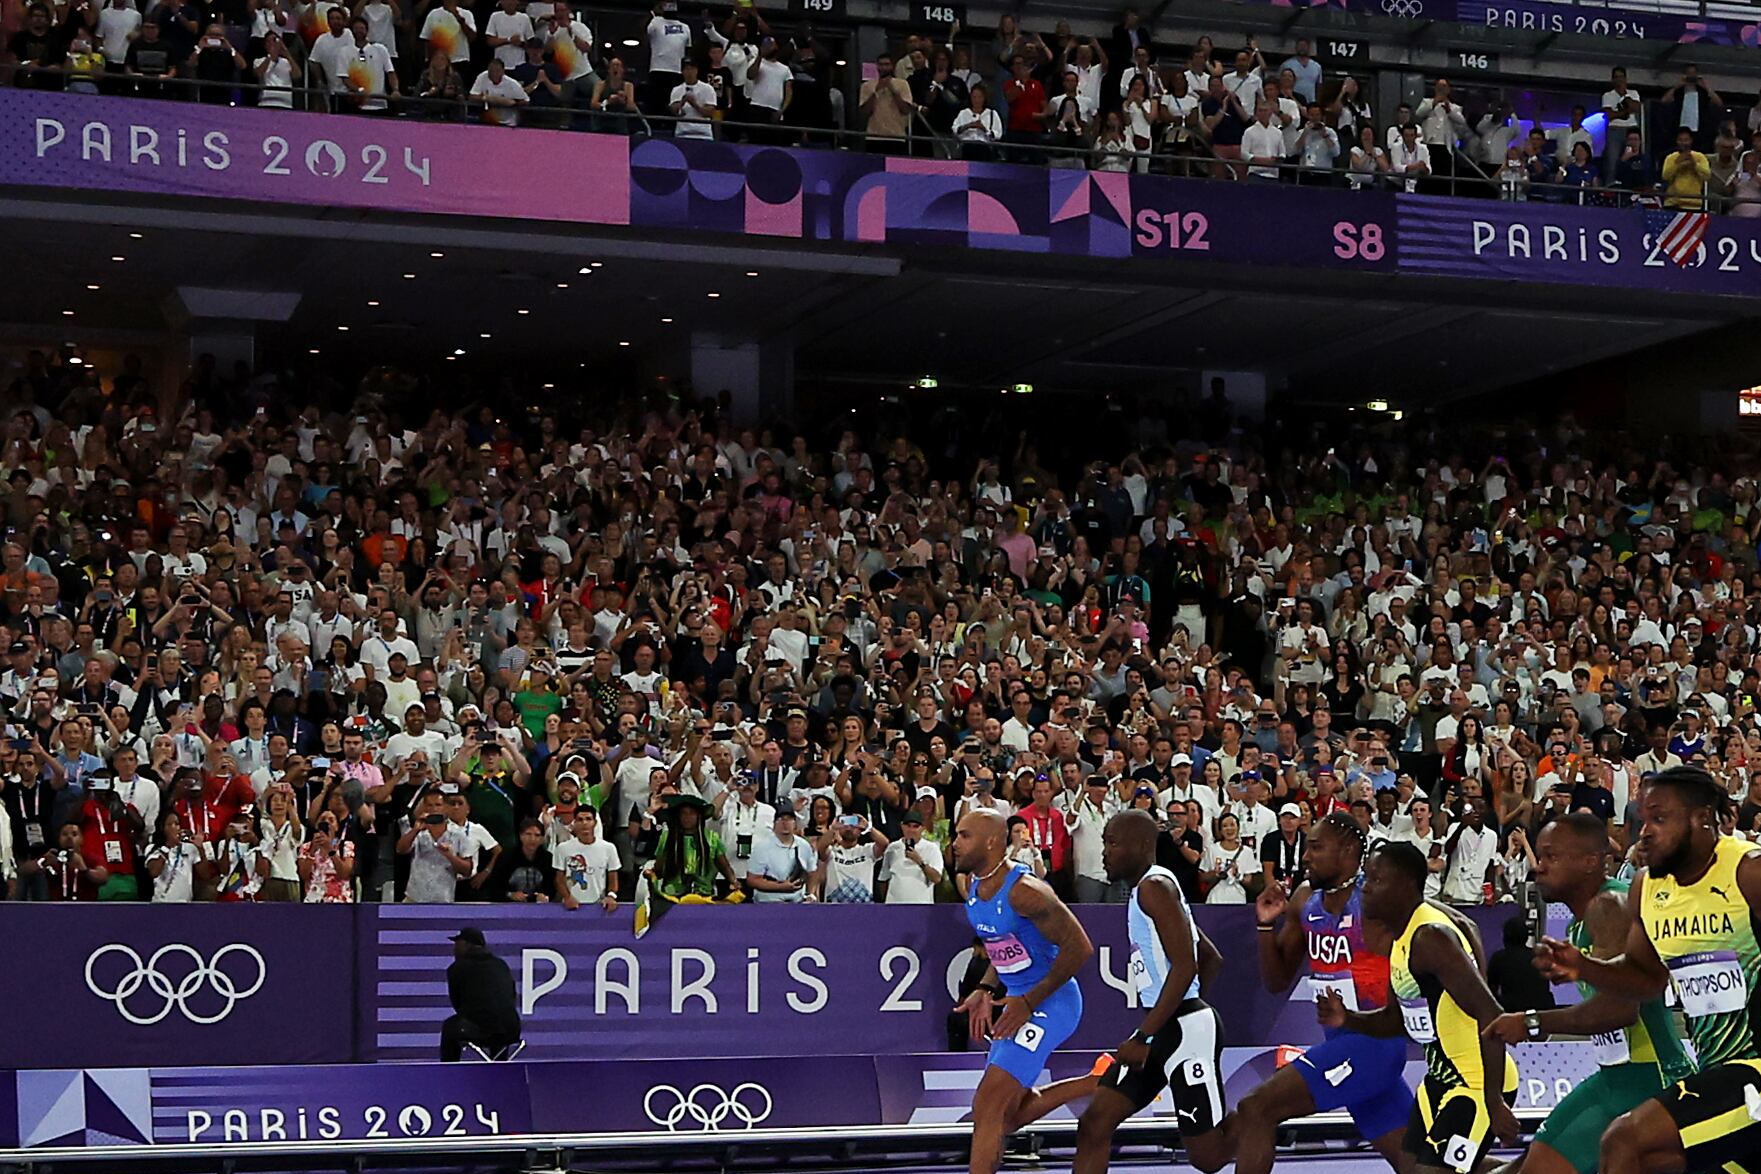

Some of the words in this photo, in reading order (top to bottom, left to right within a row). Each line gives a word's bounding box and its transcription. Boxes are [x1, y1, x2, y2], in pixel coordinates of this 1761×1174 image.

[922, 5, 954, 22] 148
[1575, 17, 1645, 39] 2024
[1329, 42, 1357, 57] 147
[1459, 54, 1488, 69] 146
[262, 136, 430, 185] 2024
[1136, 208, 1210, 250] S12
[1333, 221, 1385, 261] S8
[1654, 912, 1734, 940] JAMAICA
[1308, 930, 1352, 964] USA
[1025, 1028, 1037, 1043] 9
[1192, 1062, 1204, 1078] 8
[364, 1104, 500, 1138] 2024
[1453, 1143, 1467, 1162] 6
